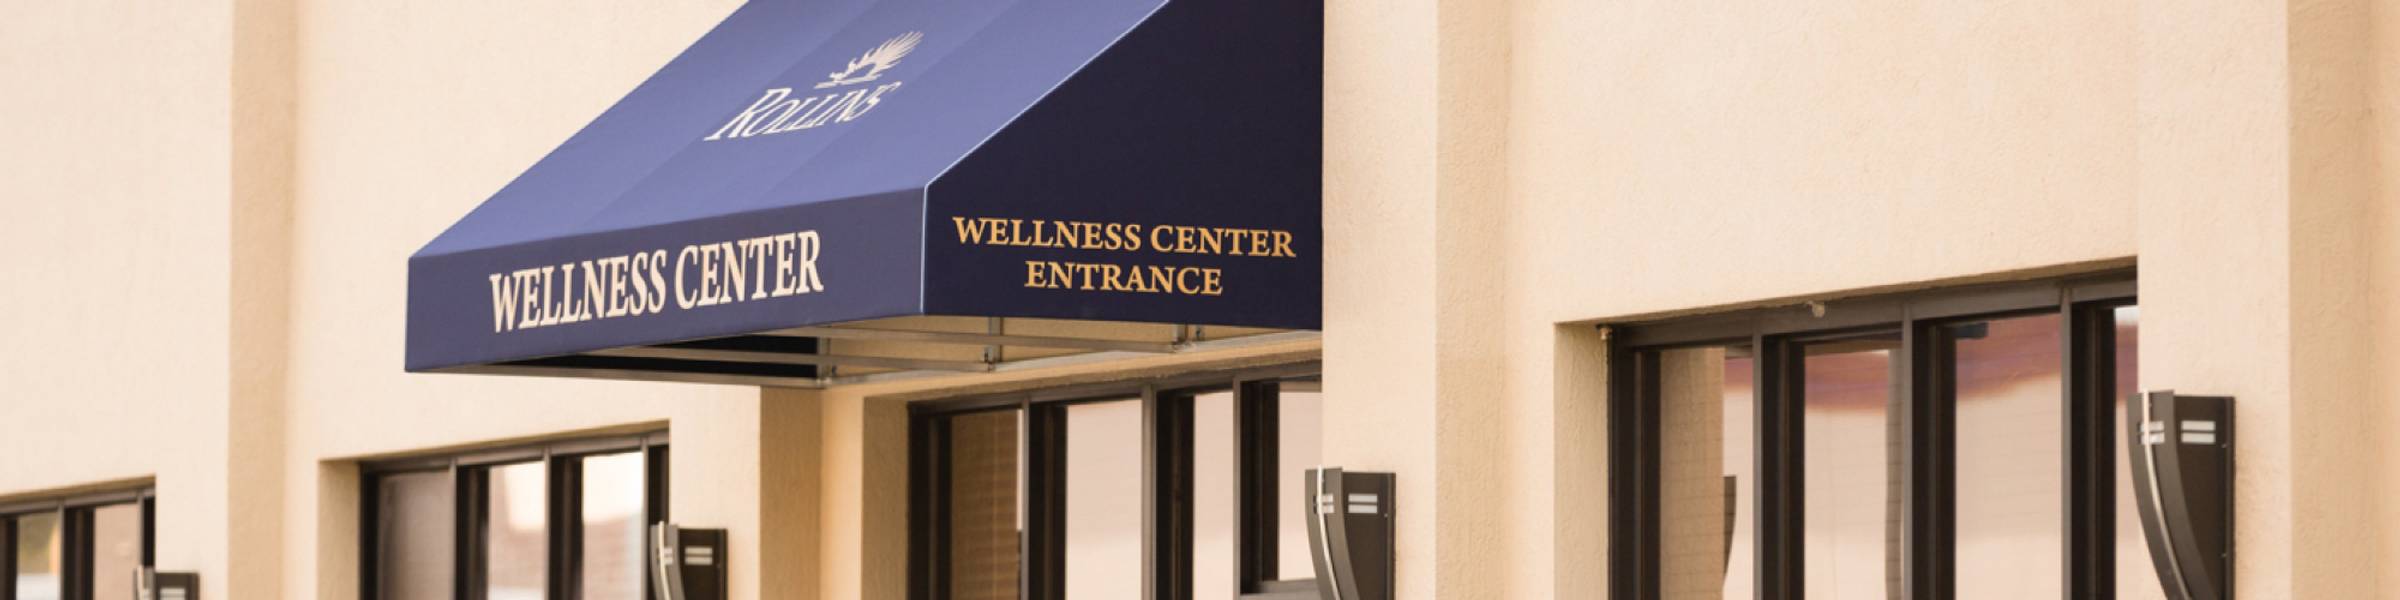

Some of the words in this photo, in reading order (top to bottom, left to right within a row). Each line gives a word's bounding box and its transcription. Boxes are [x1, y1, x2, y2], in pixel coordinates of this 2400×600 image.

[703, 81, 902, 141] ROLLINS
[953, 216, 1141, 251] WELLNESS
[1150, 224, 1296, 258] CENTER
[489, 249, 667, 333] WELLNESS
[674, 229, 825, 310] CENTER
[1025, 260, 1223, 296] ENTRANCE
